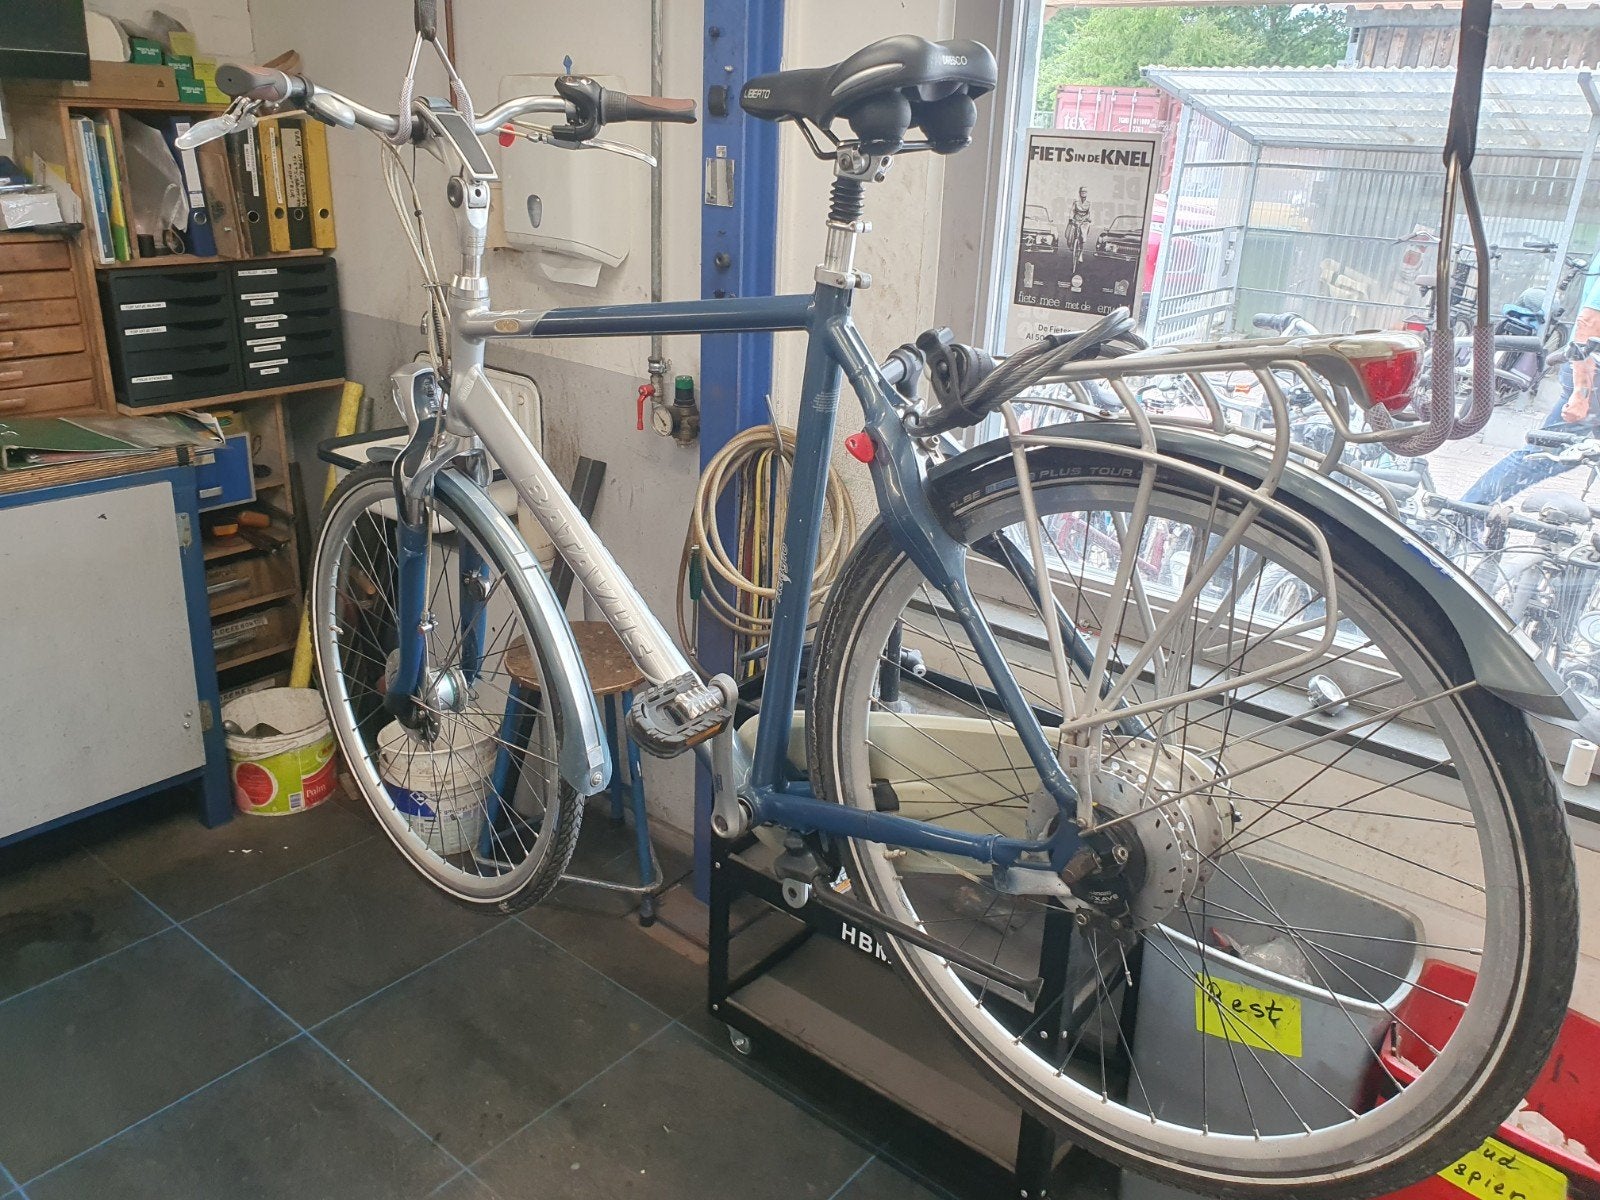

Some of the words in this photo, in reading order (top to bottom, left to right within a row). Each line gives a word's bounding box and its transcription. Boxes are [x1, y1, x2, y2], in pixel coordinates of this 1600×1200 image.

[744, 89, 771, 99] LIBERTO
[1030, 145, 1074, 163] FIETS
[1074, 153, 1086, 163] IN
[1087, 154, 1100, 163] DE
[1100, 149, 1150, 168] KNEL
[1018, 290, 1036, 304] fiets
[1039, 296, 1060, 307] mee
[1065, 300, 1080, 310] met
[1080, 300, 1091, 312] de
[1038, 324, 1048, 332] De
[1038, 467, 1081, 477] PLUS
[1089, 466, 1133, 477] TOUR
[519, 474, 653, 660] BATAVUS
[1206, 981, 1284, 1030] Rest
[1483, 1147, 1520, 1170] ud
